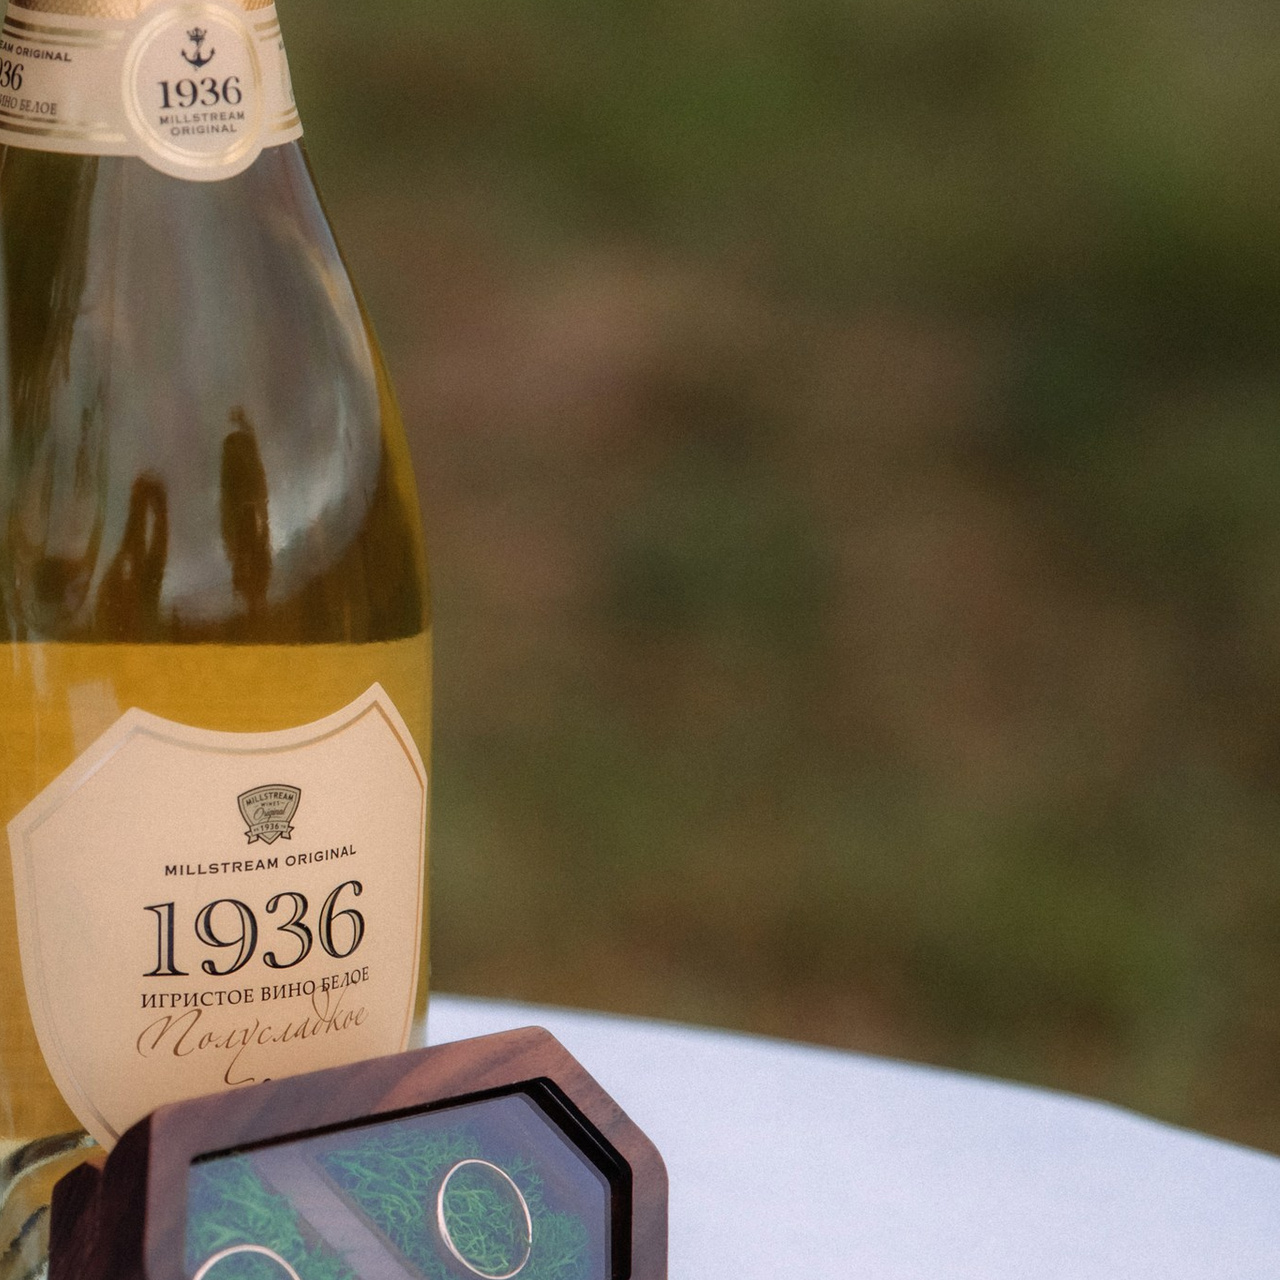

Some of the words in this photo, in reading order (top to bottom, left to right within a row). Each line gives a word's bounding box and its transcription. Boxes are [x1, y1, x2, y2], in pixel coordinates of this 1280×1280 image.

[16, 46, 72, 62] ORIGINAL
[158, 75, 243, 109] 1936
[19, 98, 57, 115] БЕЛОЕ
[160, 111, 245, 125] MILLSTREAM
[170, 124, 238, 136] ORIGINAL
[245, 791, 294, 806] MILLSTREAM
[260, 823, 279, 831] 1936
[164, 857, 279, 876] MILLSTREAM
[285, 844, 357, 867] ORIGINAL
[142, 879, 365, 977] 1936
[141, 988, 255, 1009] ИГРИСТОЕ
[260, 980, 316, 1002] ВИНО
[320, 966, 370, 992] БЕЛОЕ
[136, 984, 366, 1086] Полусладкое
